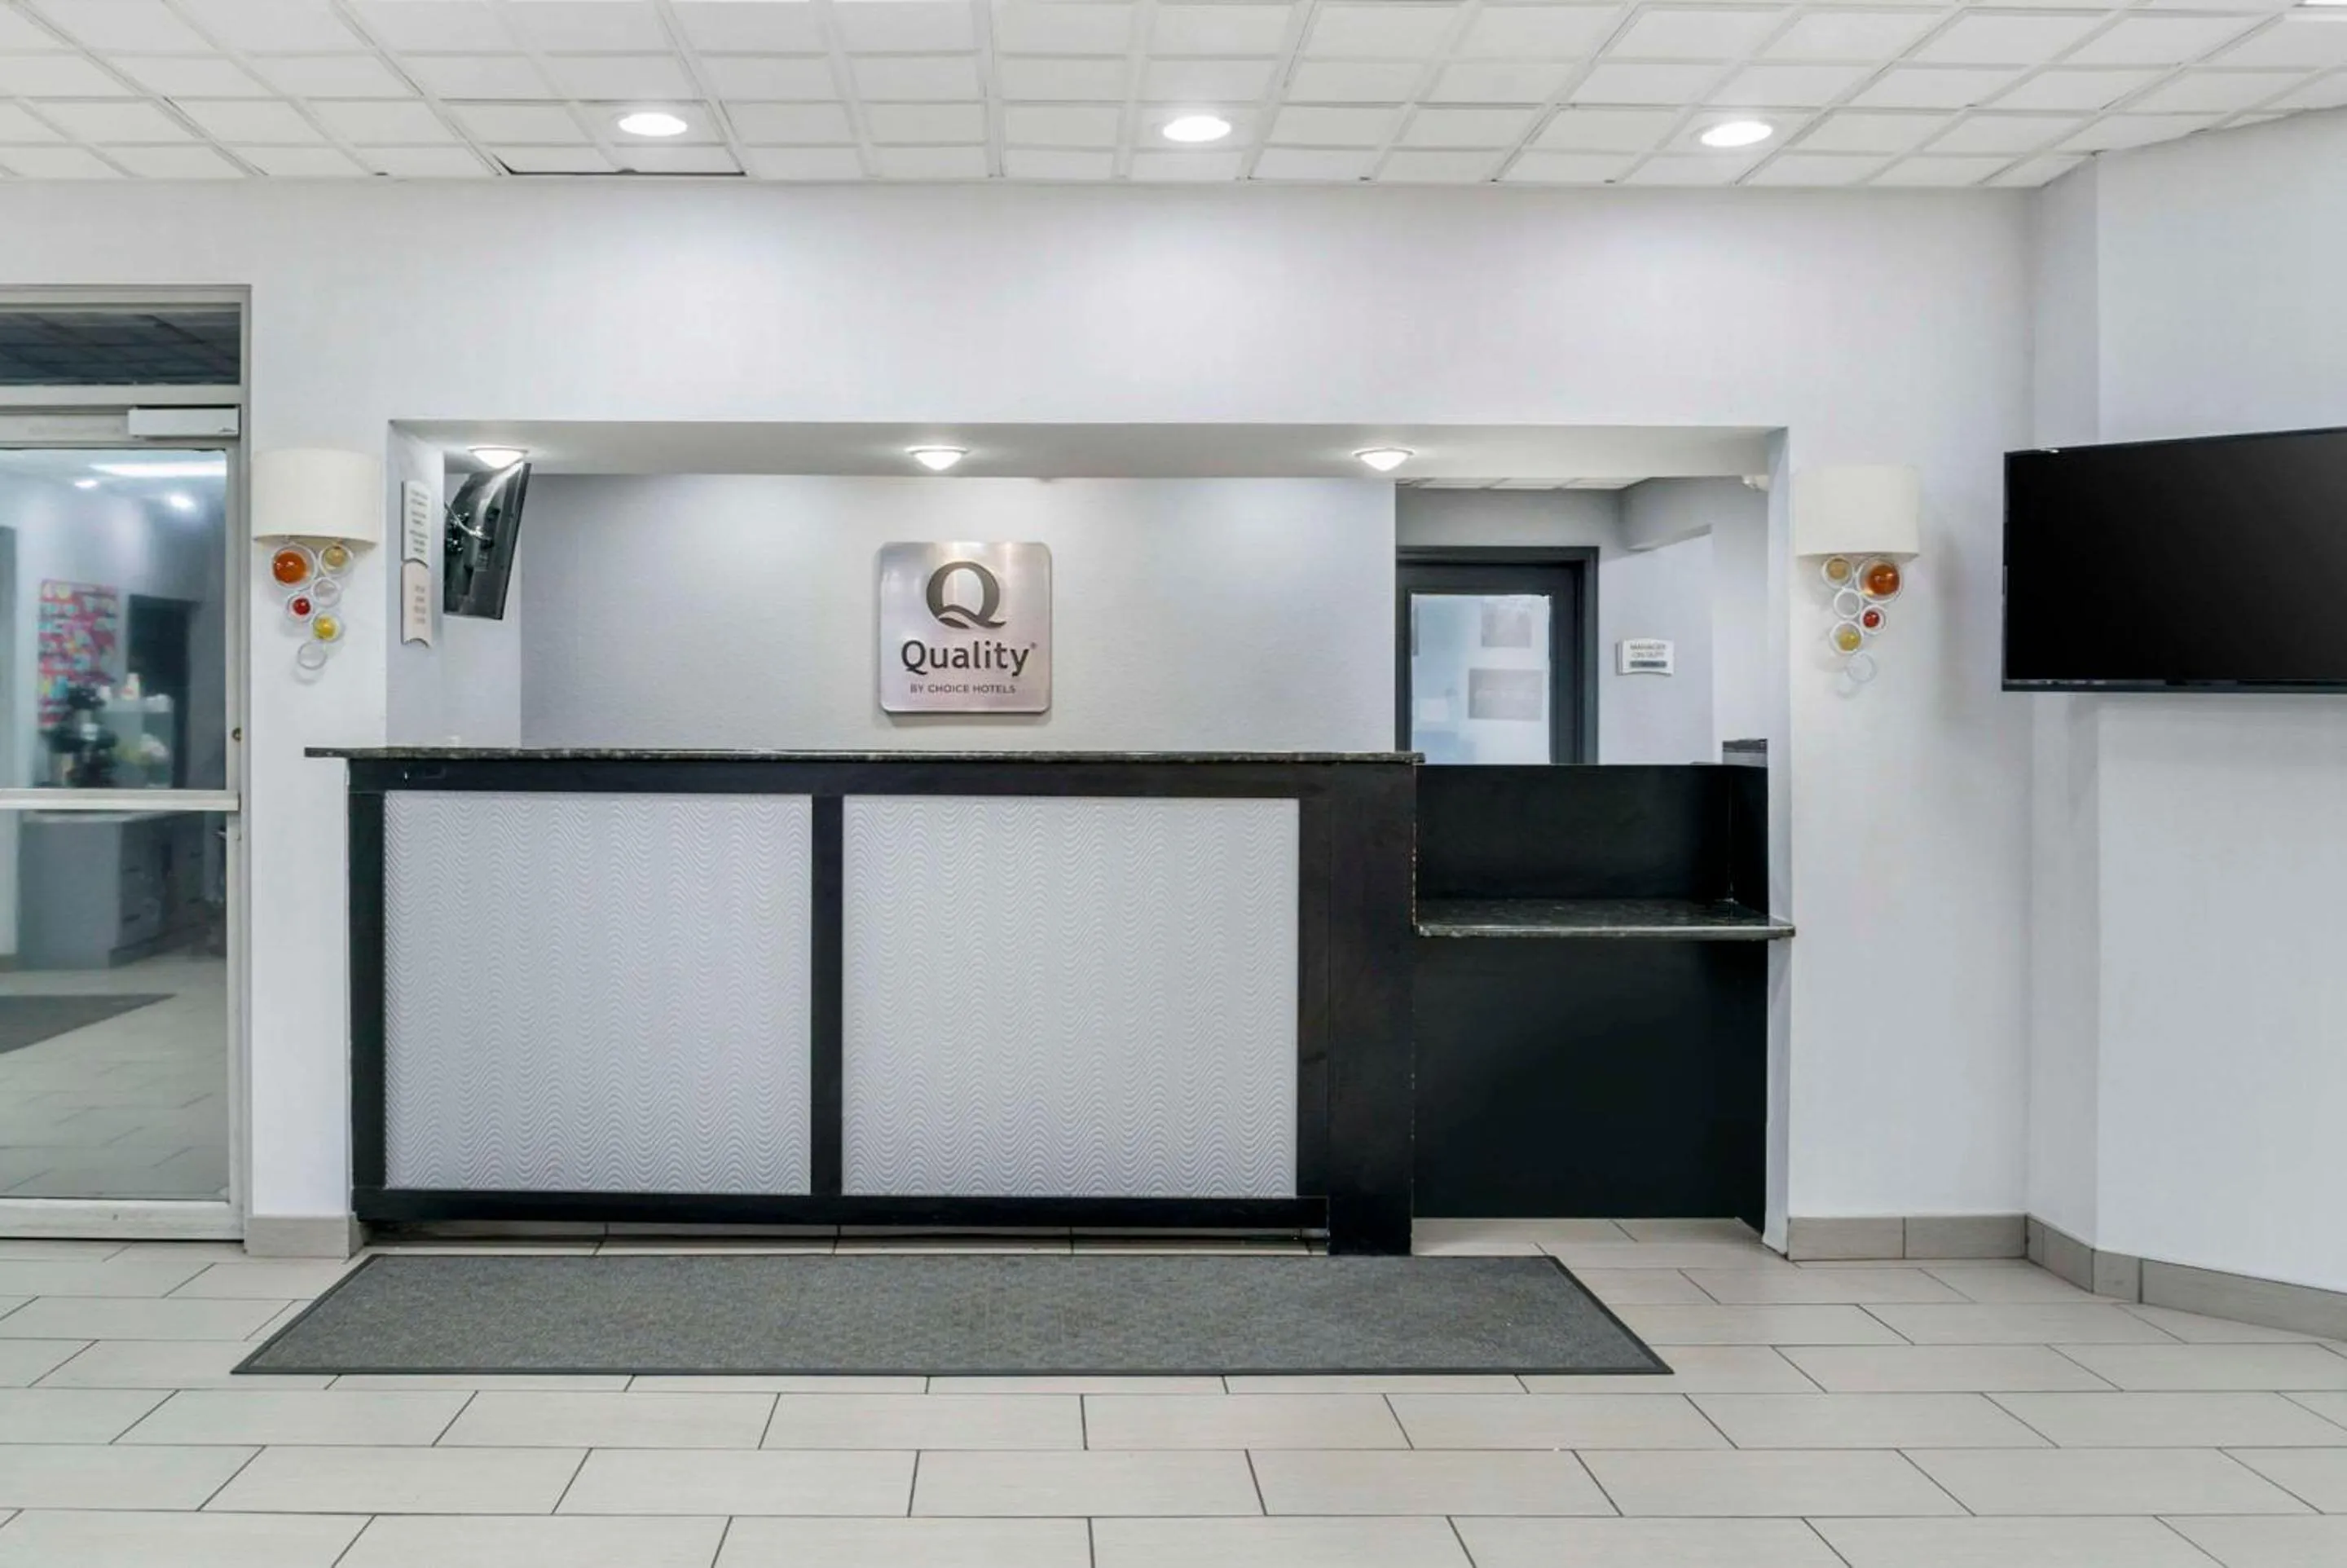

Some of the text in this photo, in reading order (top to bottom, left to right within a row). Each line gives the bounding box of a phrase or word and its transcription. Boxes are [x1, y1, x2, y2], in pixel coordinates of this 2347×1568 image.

[926, 562, 1006, 629] Q
[901, 640, 1029, 676] Quality
[910, 685, 1017, 694] BY CHOICE HOTELS
